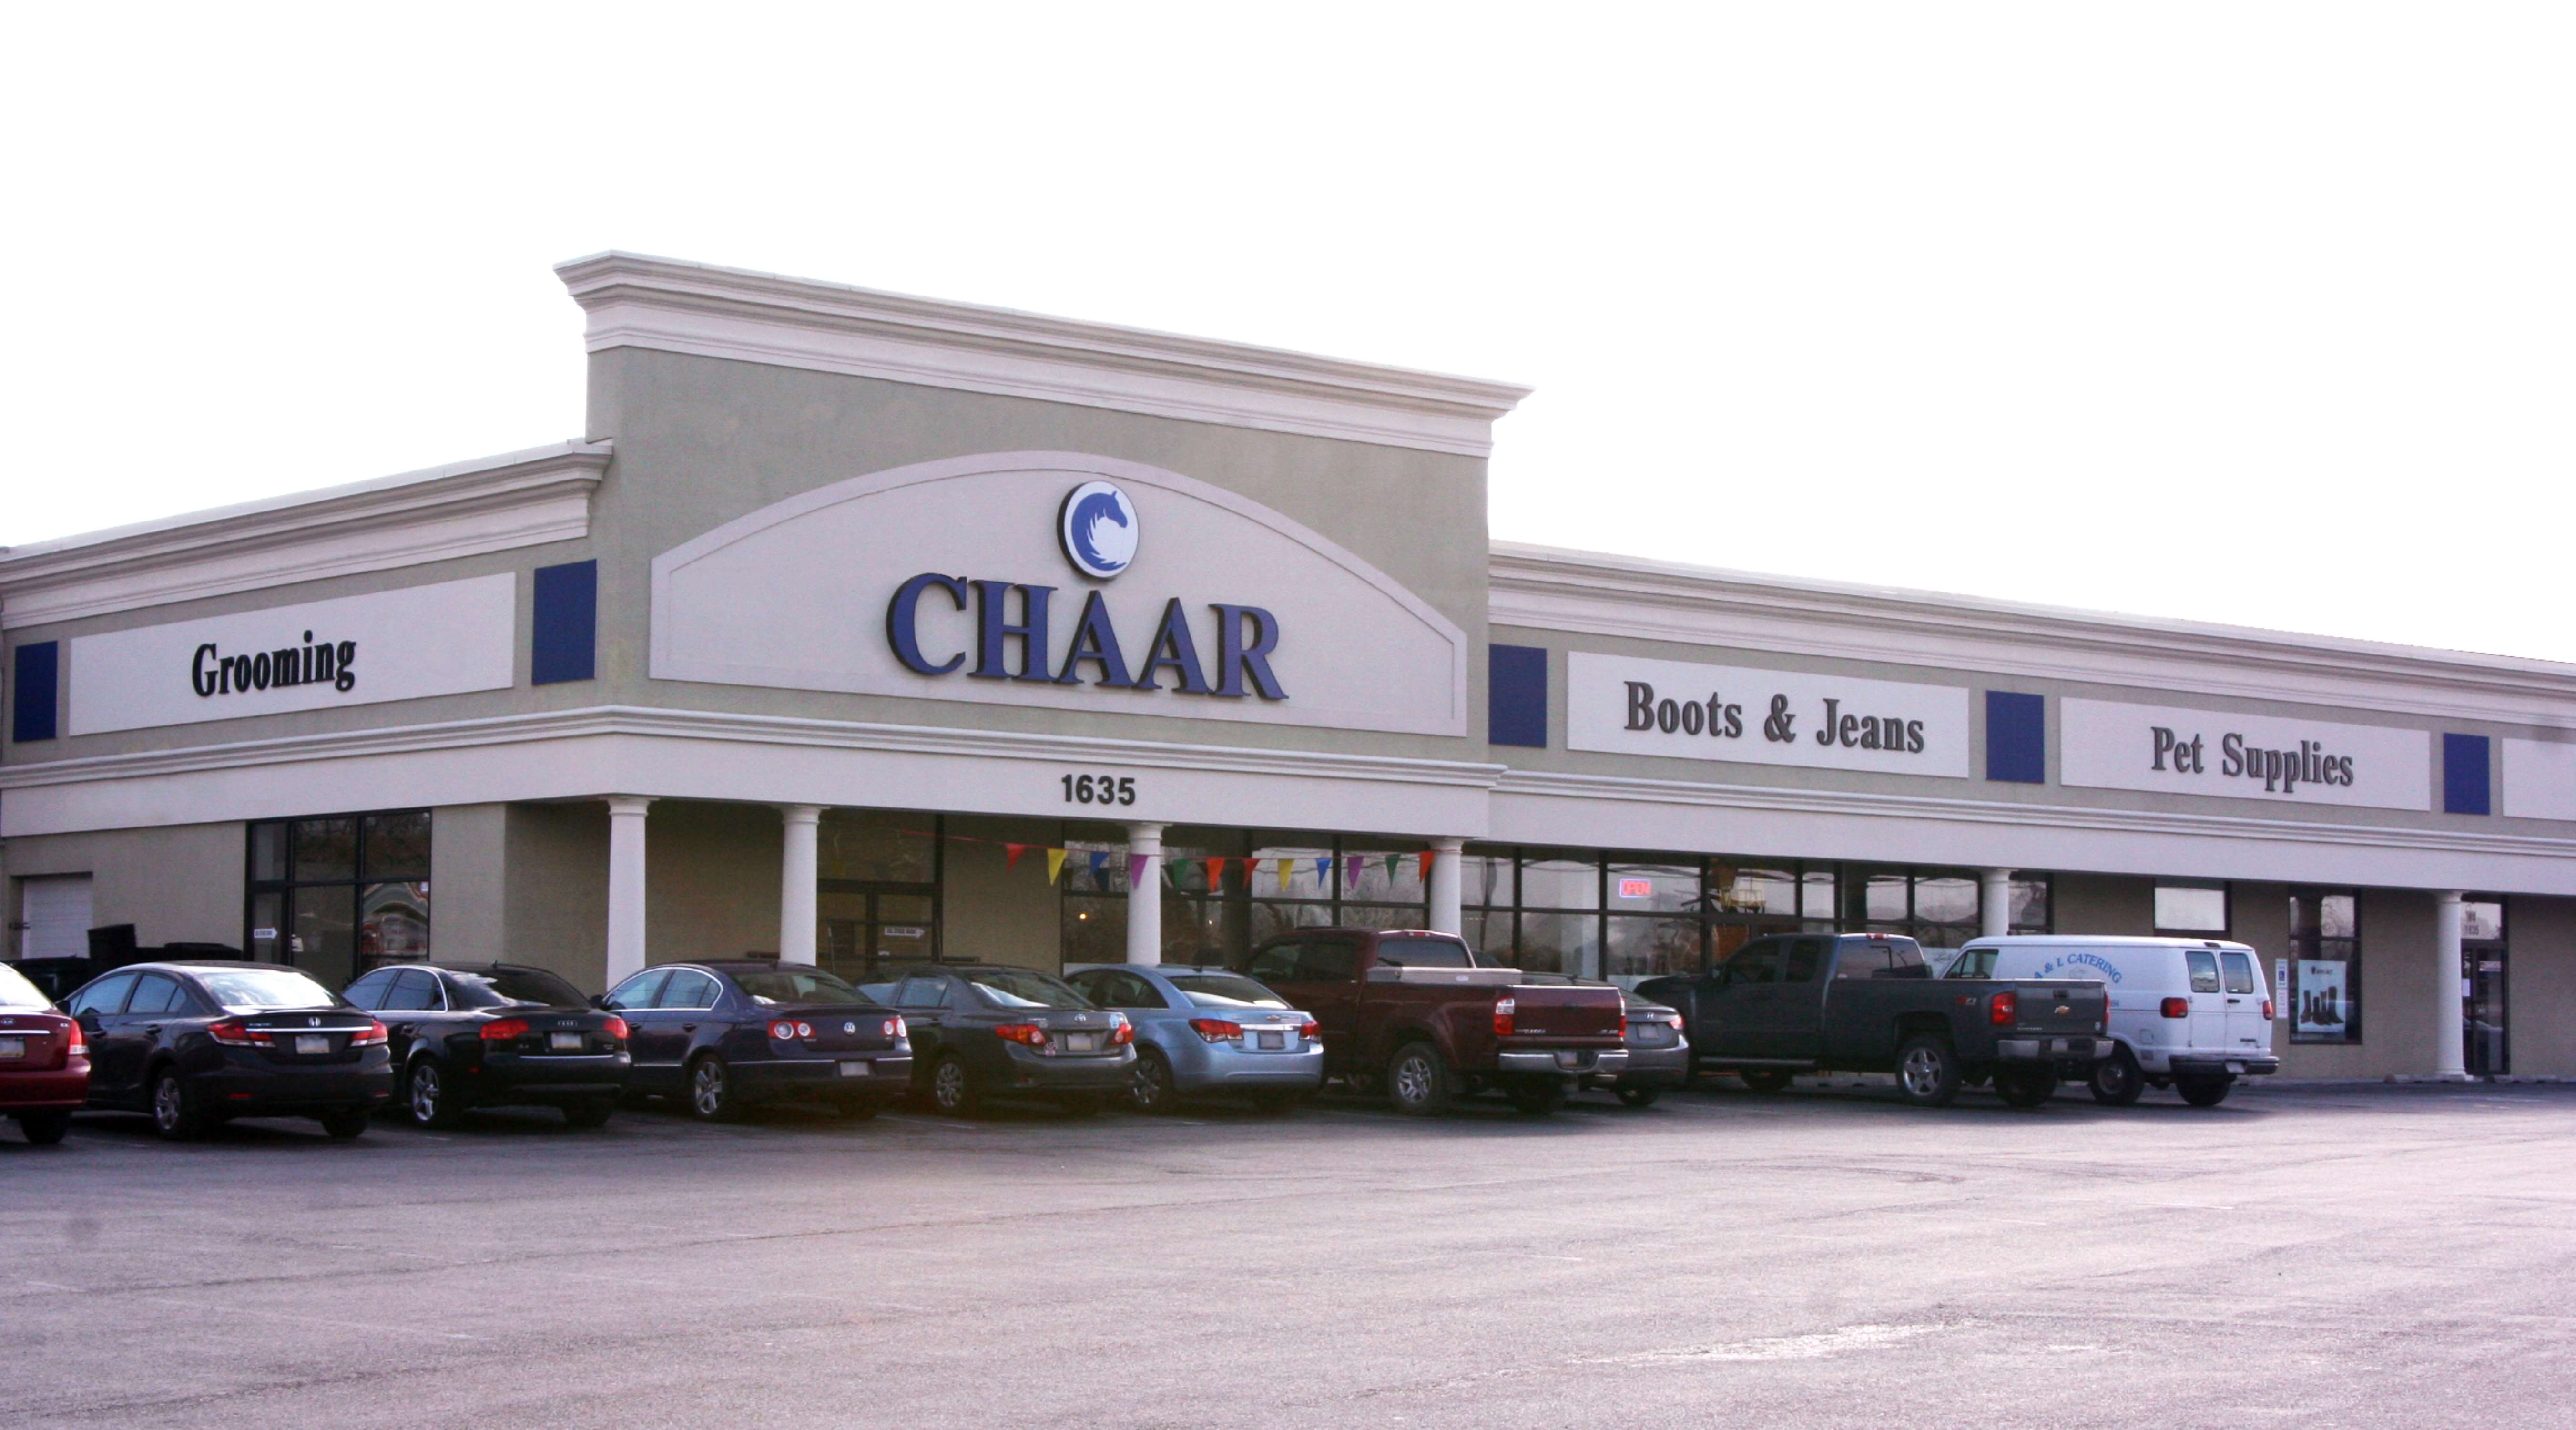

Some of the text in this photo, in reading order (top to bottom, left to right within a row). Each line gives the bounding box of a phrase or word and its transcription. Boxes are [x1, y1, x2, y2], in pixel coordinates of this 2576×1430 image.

[192, 630, 356, 697] Grooming
[886, 572, 1289, 701] CHAAR
[1624, 681, 1924, 753] Boots & Jeans
[1061, 774, 1136, 806] 1635
[2151, 726, 2353, 793] Pet Supplies
[1623, 881, 1651, 895] OPEN
[2044, 962, 2054, 973] &
[2067, 953, 2122, 983] CATERING
